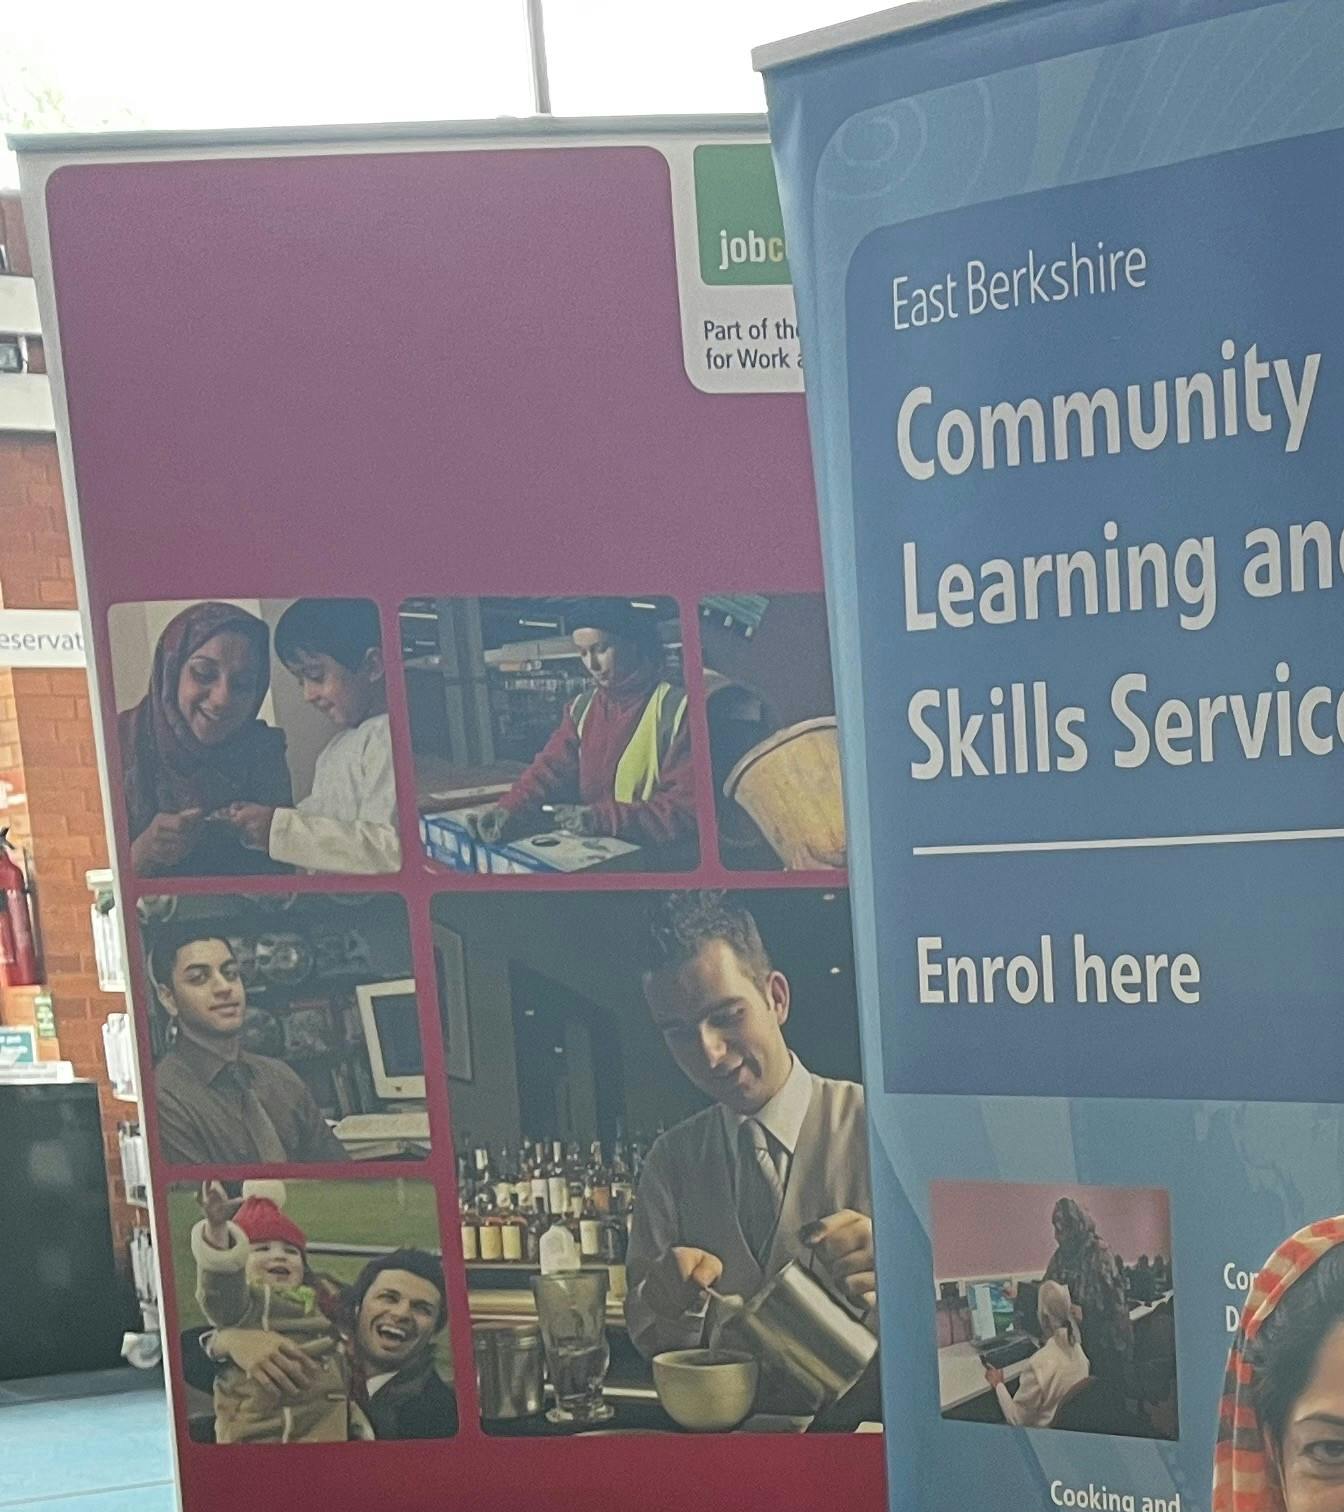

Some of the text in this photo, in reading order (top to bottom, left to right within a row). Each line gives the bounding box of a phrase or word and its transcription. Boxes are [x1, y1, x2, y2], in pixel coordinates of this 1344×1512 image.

[703, 320, 743, 341] Part
[749, 317, 768, 339] of
[893, 241, 1147, 330] East Berkshire
[706, 347, 733, 370] for
[737, 346, 791, 369] Work
[897, 339, 1321, 480] Community
[902, 522, 1216, 631] Learning
[907, 681, 1088, 780] Skills
[917, 934, 1201, 1005] Enrol here
